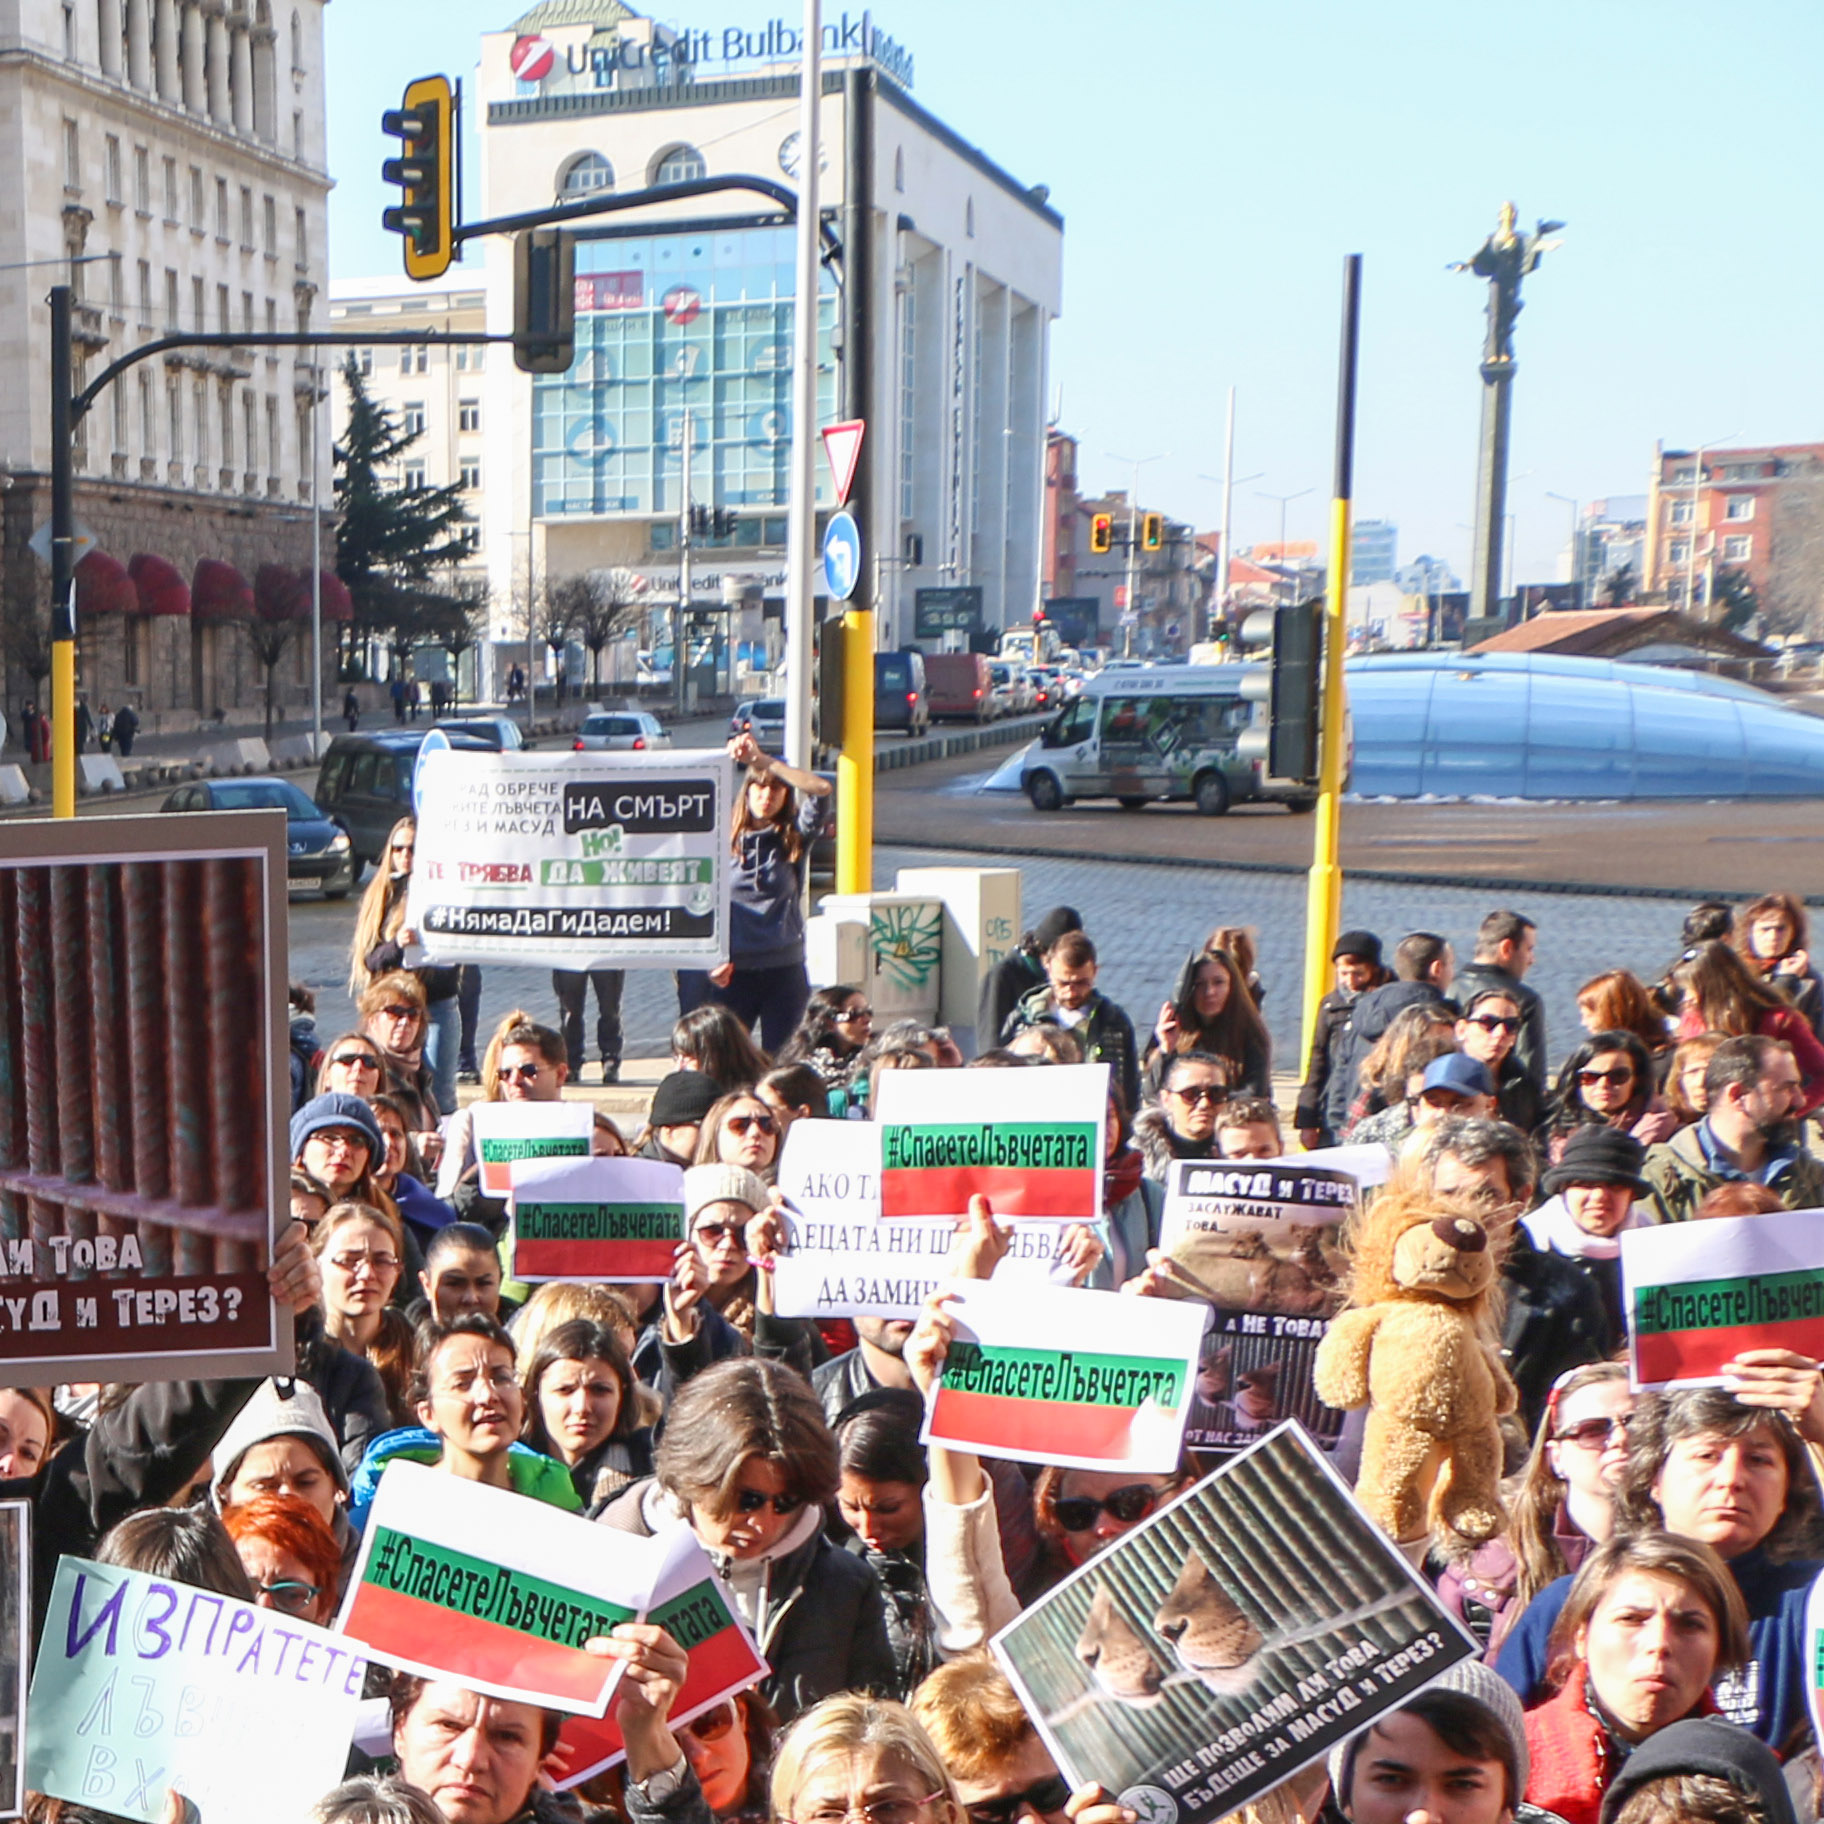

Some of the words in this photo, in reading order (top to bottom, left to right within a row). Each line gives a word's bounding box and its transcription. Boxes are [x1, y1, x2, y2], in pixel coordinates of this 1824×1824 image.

[566, 29, 713, 75] UniCredit
[496, 782, 559, 796] ОБРЕЧЕ
[492, 801, 562, 816] ЛЪВЧЕТА
[568, 796, 606, 820] НА
[615, 794, 710, 818] СМЪРТ
[494, 820, 555, 836] МАСУД
[581, 827, 622, 857] НО!
[460, 862, 532, 882] ТРЯБВА
[548, 862, 585, 884] ДА
[602, 859, 701, 883] ЖИВЕЯТ
[431, 909, 672, 934] #НямаДаГиДадем!
[888, 1125, 1089, 1167] #СпасетеЛъвчетата
[801, 1173, 851, 1199] АКО
[1187, 1171, 1273, 1198] МАСУД
[1299, 1177, 1354, 1207] ТЕРЕЗ
[519, 1204, 682, 1242] #СпасетеЛъвчетата
[1187, 1202, 1284, 1221] ЗАСЛУЖАВАТ
[48, 1233, 143, 1275] ТОВА
[788, 1227, 880, 1256] ДЕЦАТА
[889, 1228, 921, 1252] НИ
[112, 1287, 244, 1328] ТЕРЕЗ?
[817, 1280, 848, 1308] ДА
[854, 1280, 939, 1304] ЗАМИН
[1643, 1276, 1824, 1332] #СпасетеЛъвчет
[1242, 1315, 1266, 1334] НЕ
[948, 1351, 1177, 1410] #СпасетеЛъвчетата
[1204, 1430, 1231, 1443] НАС
[373, 1531, 623, 1651] #СпасетеЛъвчетата
[65, 1574, 368, 1695] ИЗПРАТЕТЕ
[1162, 1759, 1200, 1790] ЩЕ
[1196, 1692, 1299, 1767] ПОЗВОЛИМ
[1296, 1673, 1330, 1702] ЛИ
[1325, 1640, 1380, 1679] ТОВА
[1182, 1751, 1266, 1811] БЪДЕЩЕ
[1287, 1686, 1362, 1743] МАСУД
[1373, 1632, 1445, 1685] ТЕРЕЗ?
